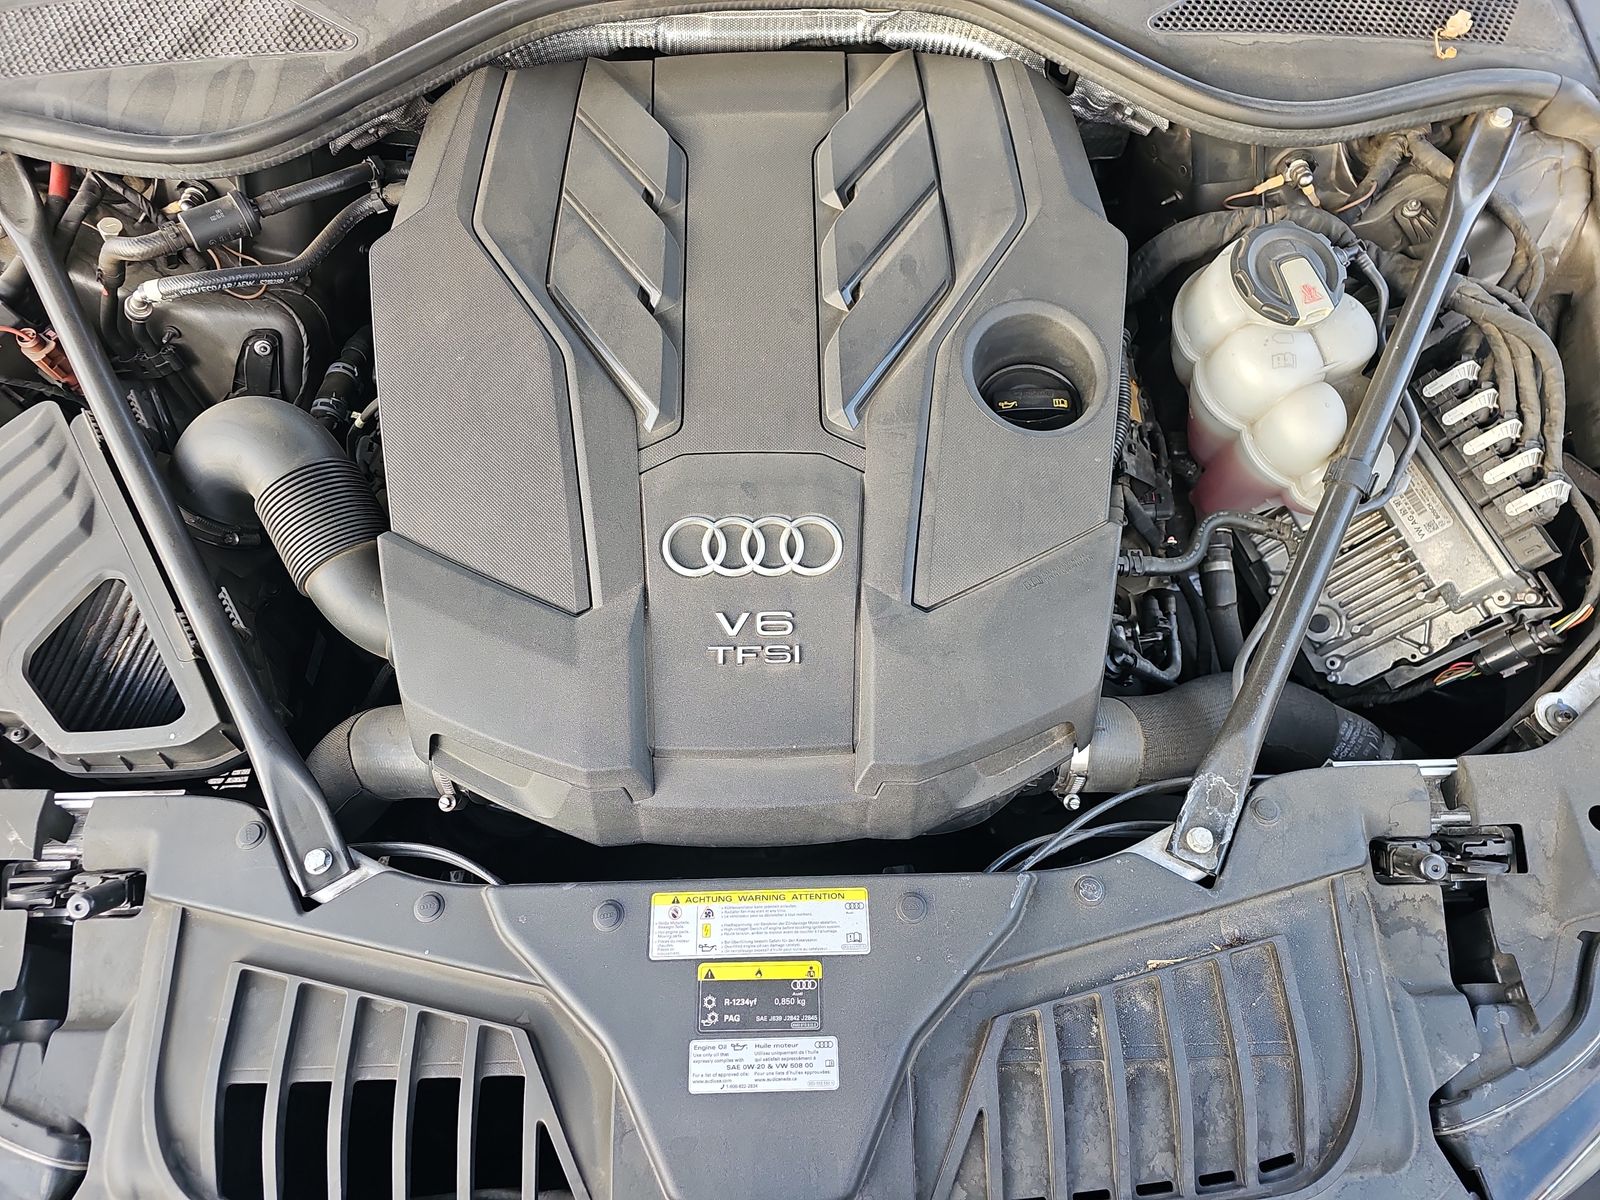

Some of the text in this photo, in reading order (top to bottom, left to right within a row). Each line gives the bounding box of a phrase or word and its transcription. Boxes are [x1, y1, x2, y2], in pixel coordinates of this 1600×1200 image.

[1426, 502, 1441, 520] BOSCH
[1406, 514, 1418, 527] AG
[1414, 524, 1426, 540] VW
[715, 610, 795, 637] V6
[706, 644, 801, 666] TFSI
[685, 892, 845, 904] ACHTUNG WARNING ATTENTION
[724, 997, 758, 1007] R-1234yf
[774, 997, 806, 1007] 0,850 kg
